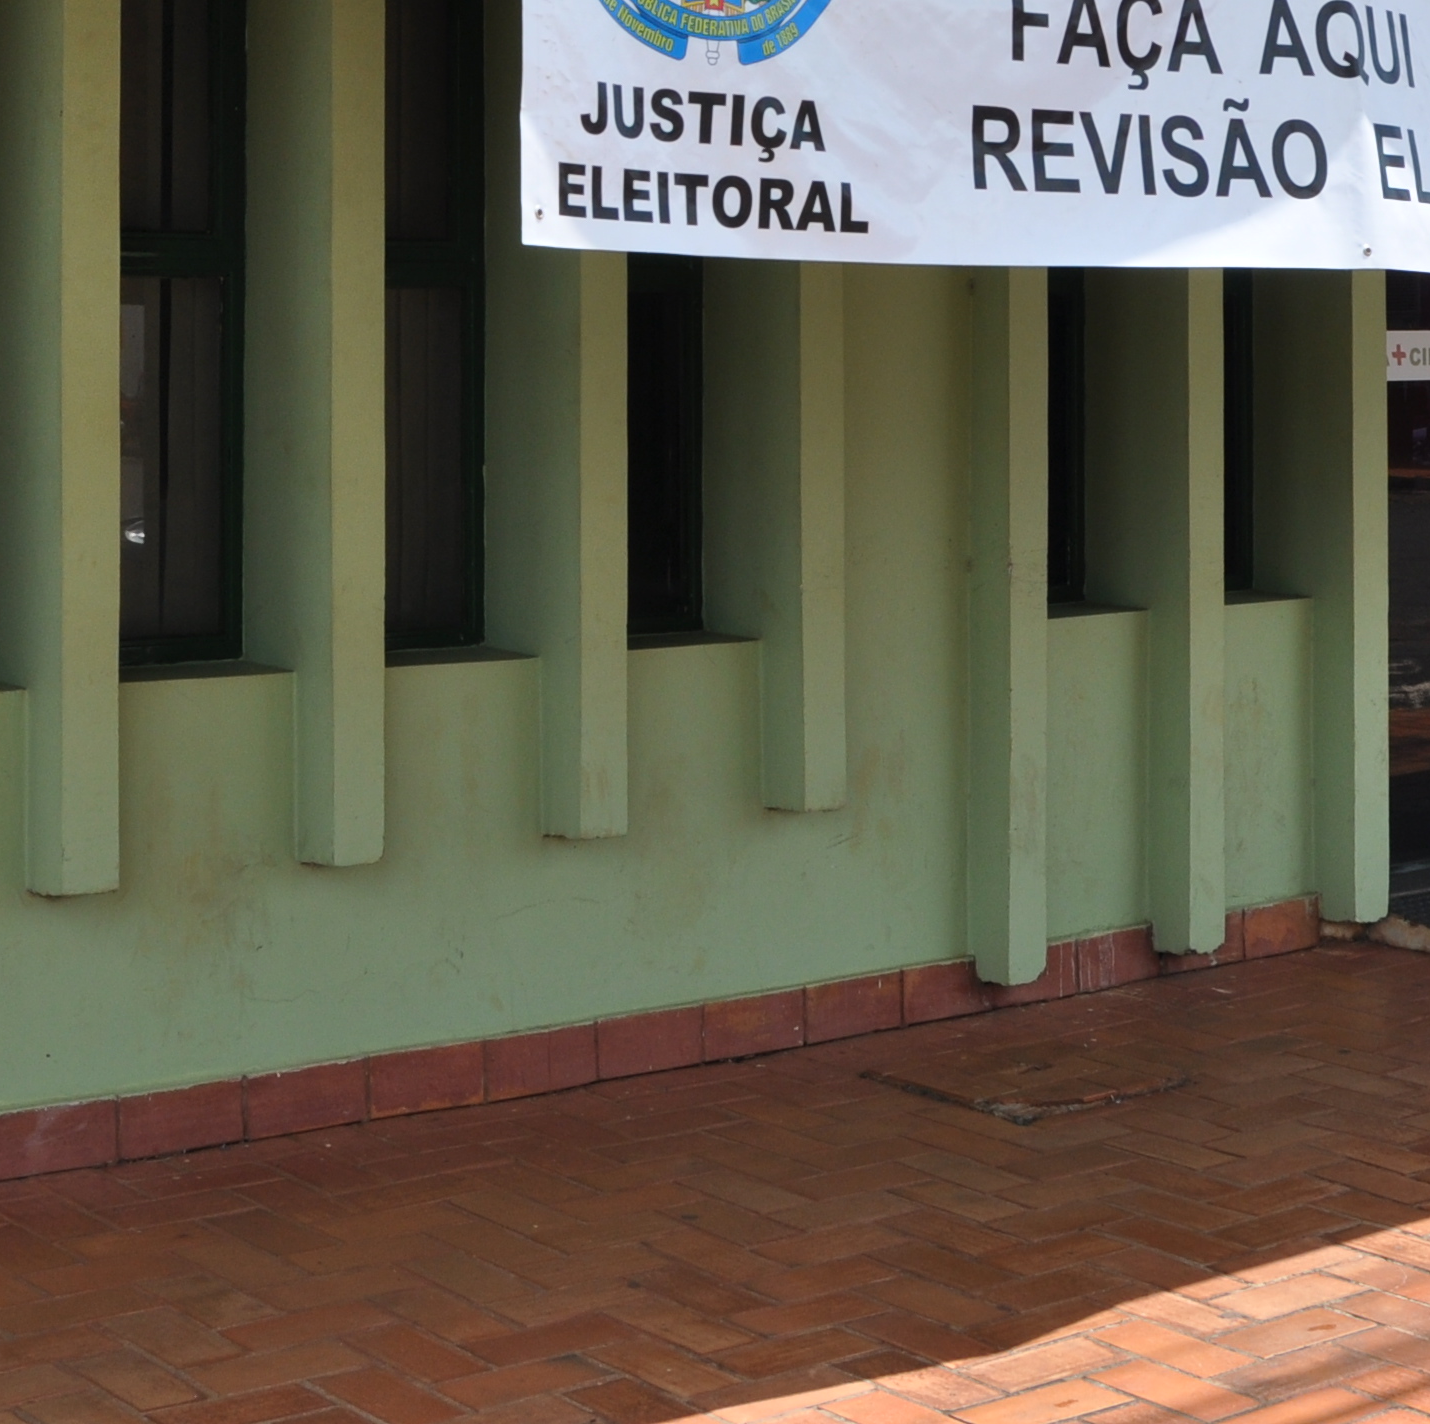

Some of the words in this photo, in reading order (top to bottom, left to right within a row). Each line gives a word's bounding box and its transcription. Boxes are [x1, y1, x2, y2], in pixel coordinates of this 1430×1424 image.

[617, 4, 675, 52] Novembro
[762, 38, 776, 57] de
[776, 21, 800, 48] 1889
[680, 13, 750, 37] FEDERATIVA
[751, 14, 765, 31] DO
[579, 81, 827, 163] JUSTIÇA
[970, 96, 1328, 200] REVISÃO
[557, 161, 870, 234] ELEITORAL
